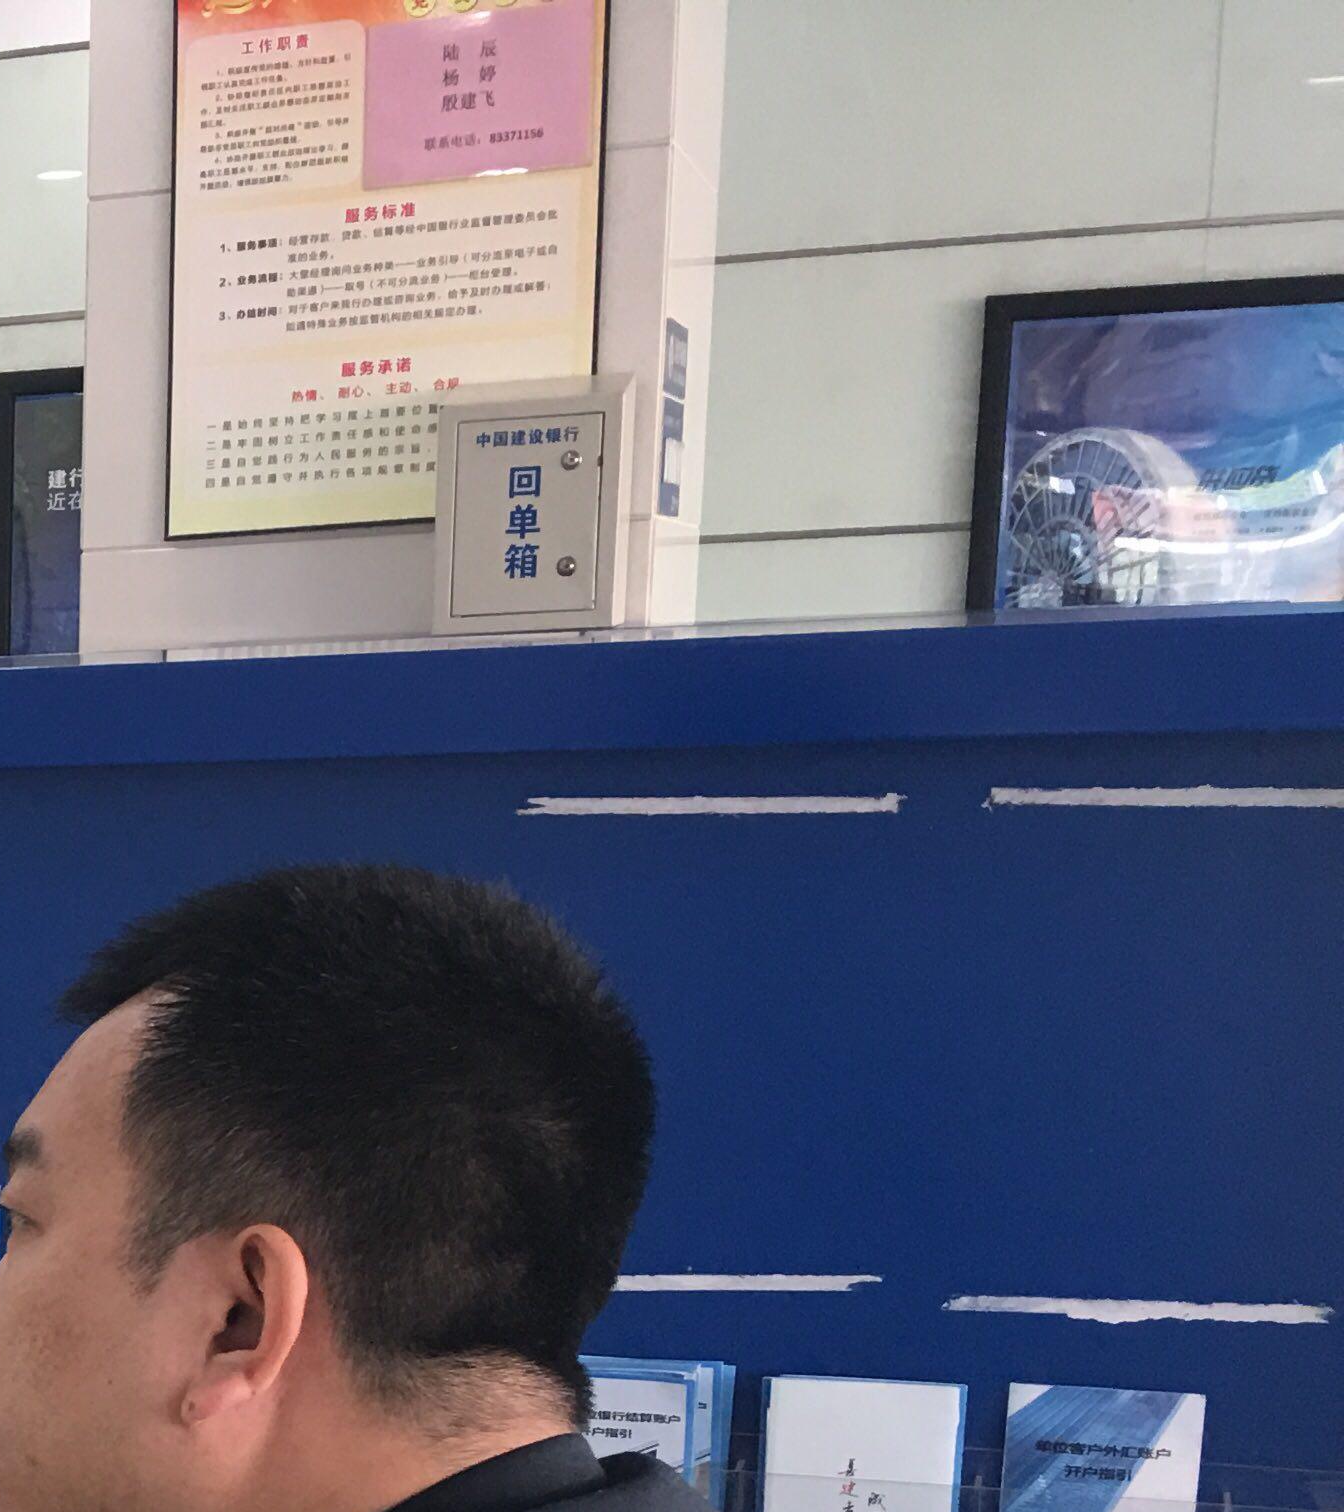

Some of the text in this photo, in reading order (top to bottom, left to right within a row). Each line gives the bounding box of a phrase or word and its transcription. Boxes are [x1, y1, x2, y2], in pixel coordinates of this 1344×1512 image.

[241, 34, 309, 55] 工作职责
[345, 202, 416, 223] 服务标准
[341, 357, 412, 377] 服务承诺
[476, 426, 580, 448] 中国建设银行
[48, 467, 83, 489] 建行
[47, 492, 82, 511] 近在
[504, 466, 542, 579] 回单箱
[588, 1410, 681, 1425] 银行结算账户
[1035, 1440, 1171, 1460] 单位客户外汇账户
[1064, 1464, 1132, 1482] 开户指引
